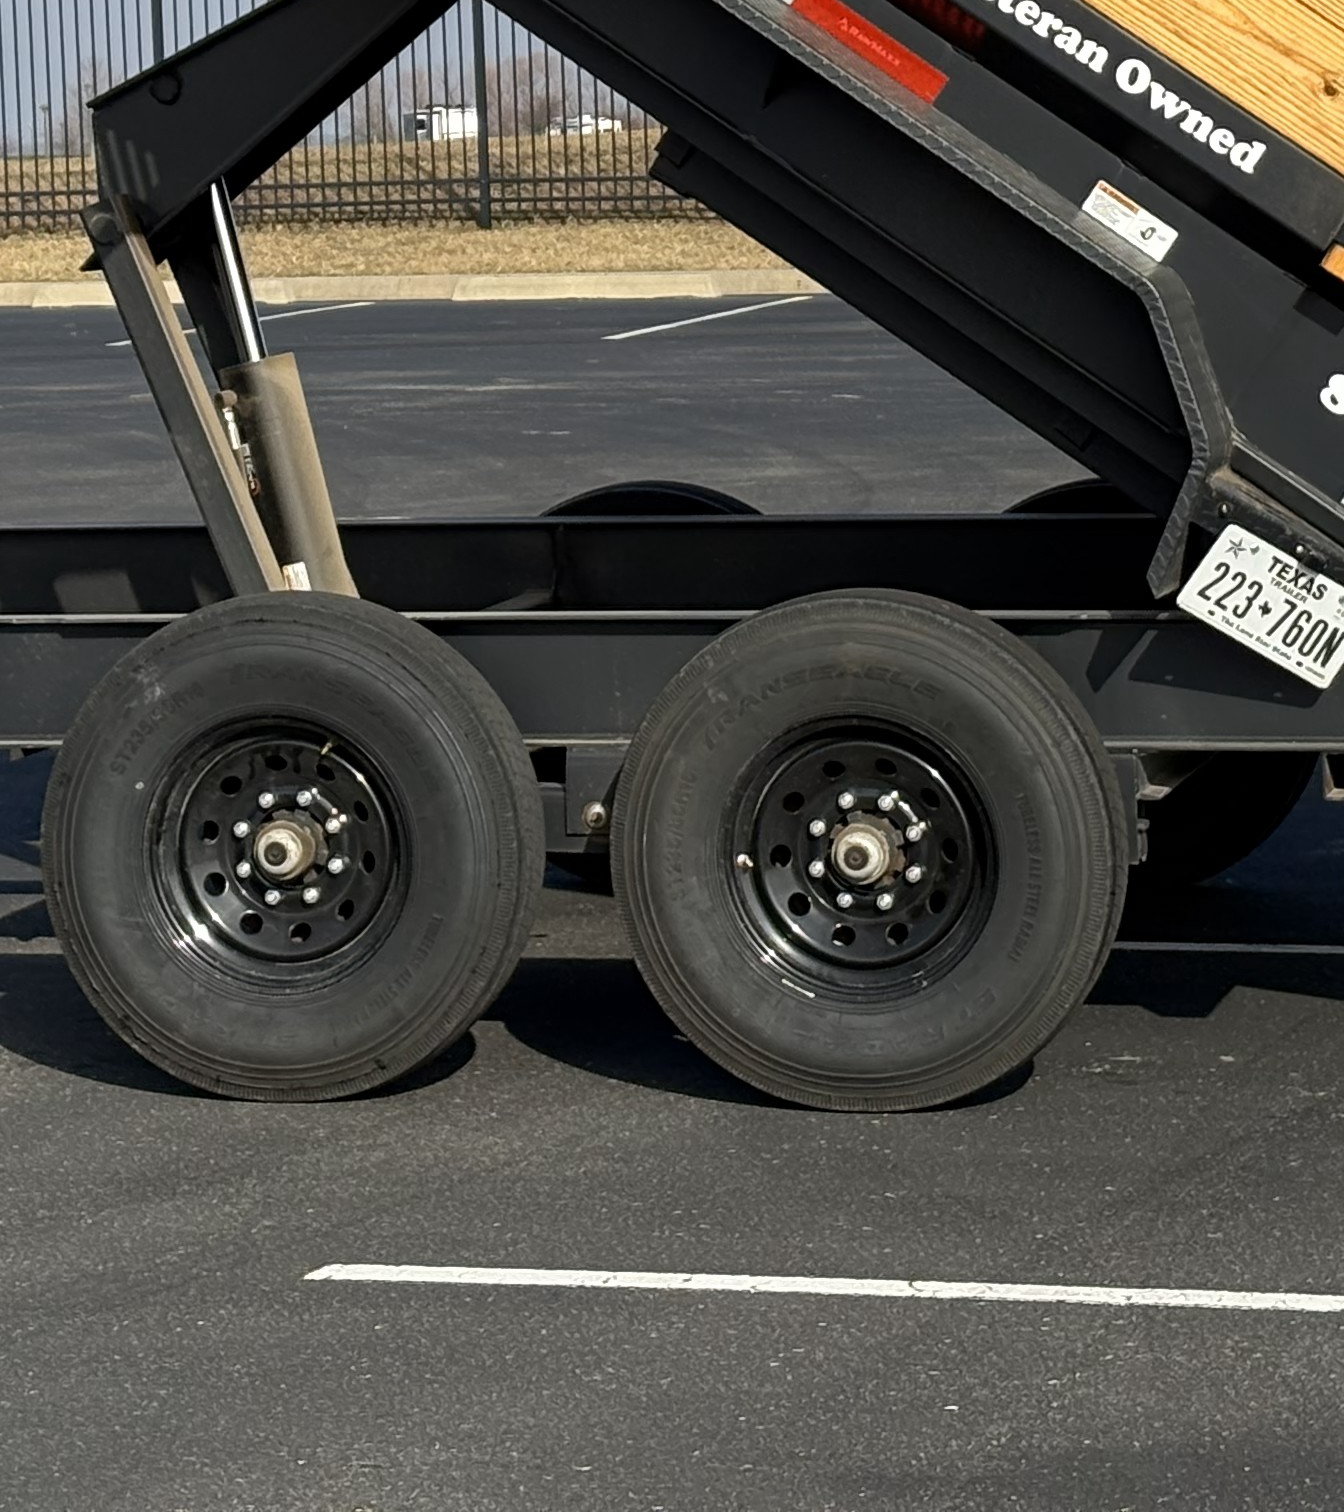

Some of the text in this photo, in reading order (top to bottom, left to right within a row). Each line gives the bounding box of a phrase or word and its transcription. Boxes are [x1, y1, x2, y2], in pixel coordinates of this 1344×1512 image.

[1115, 58, 1267, 175] Owned
[1267, 555, 1328, 601] TEXAS
[1270, 577, 1309, 604] TRAILER
